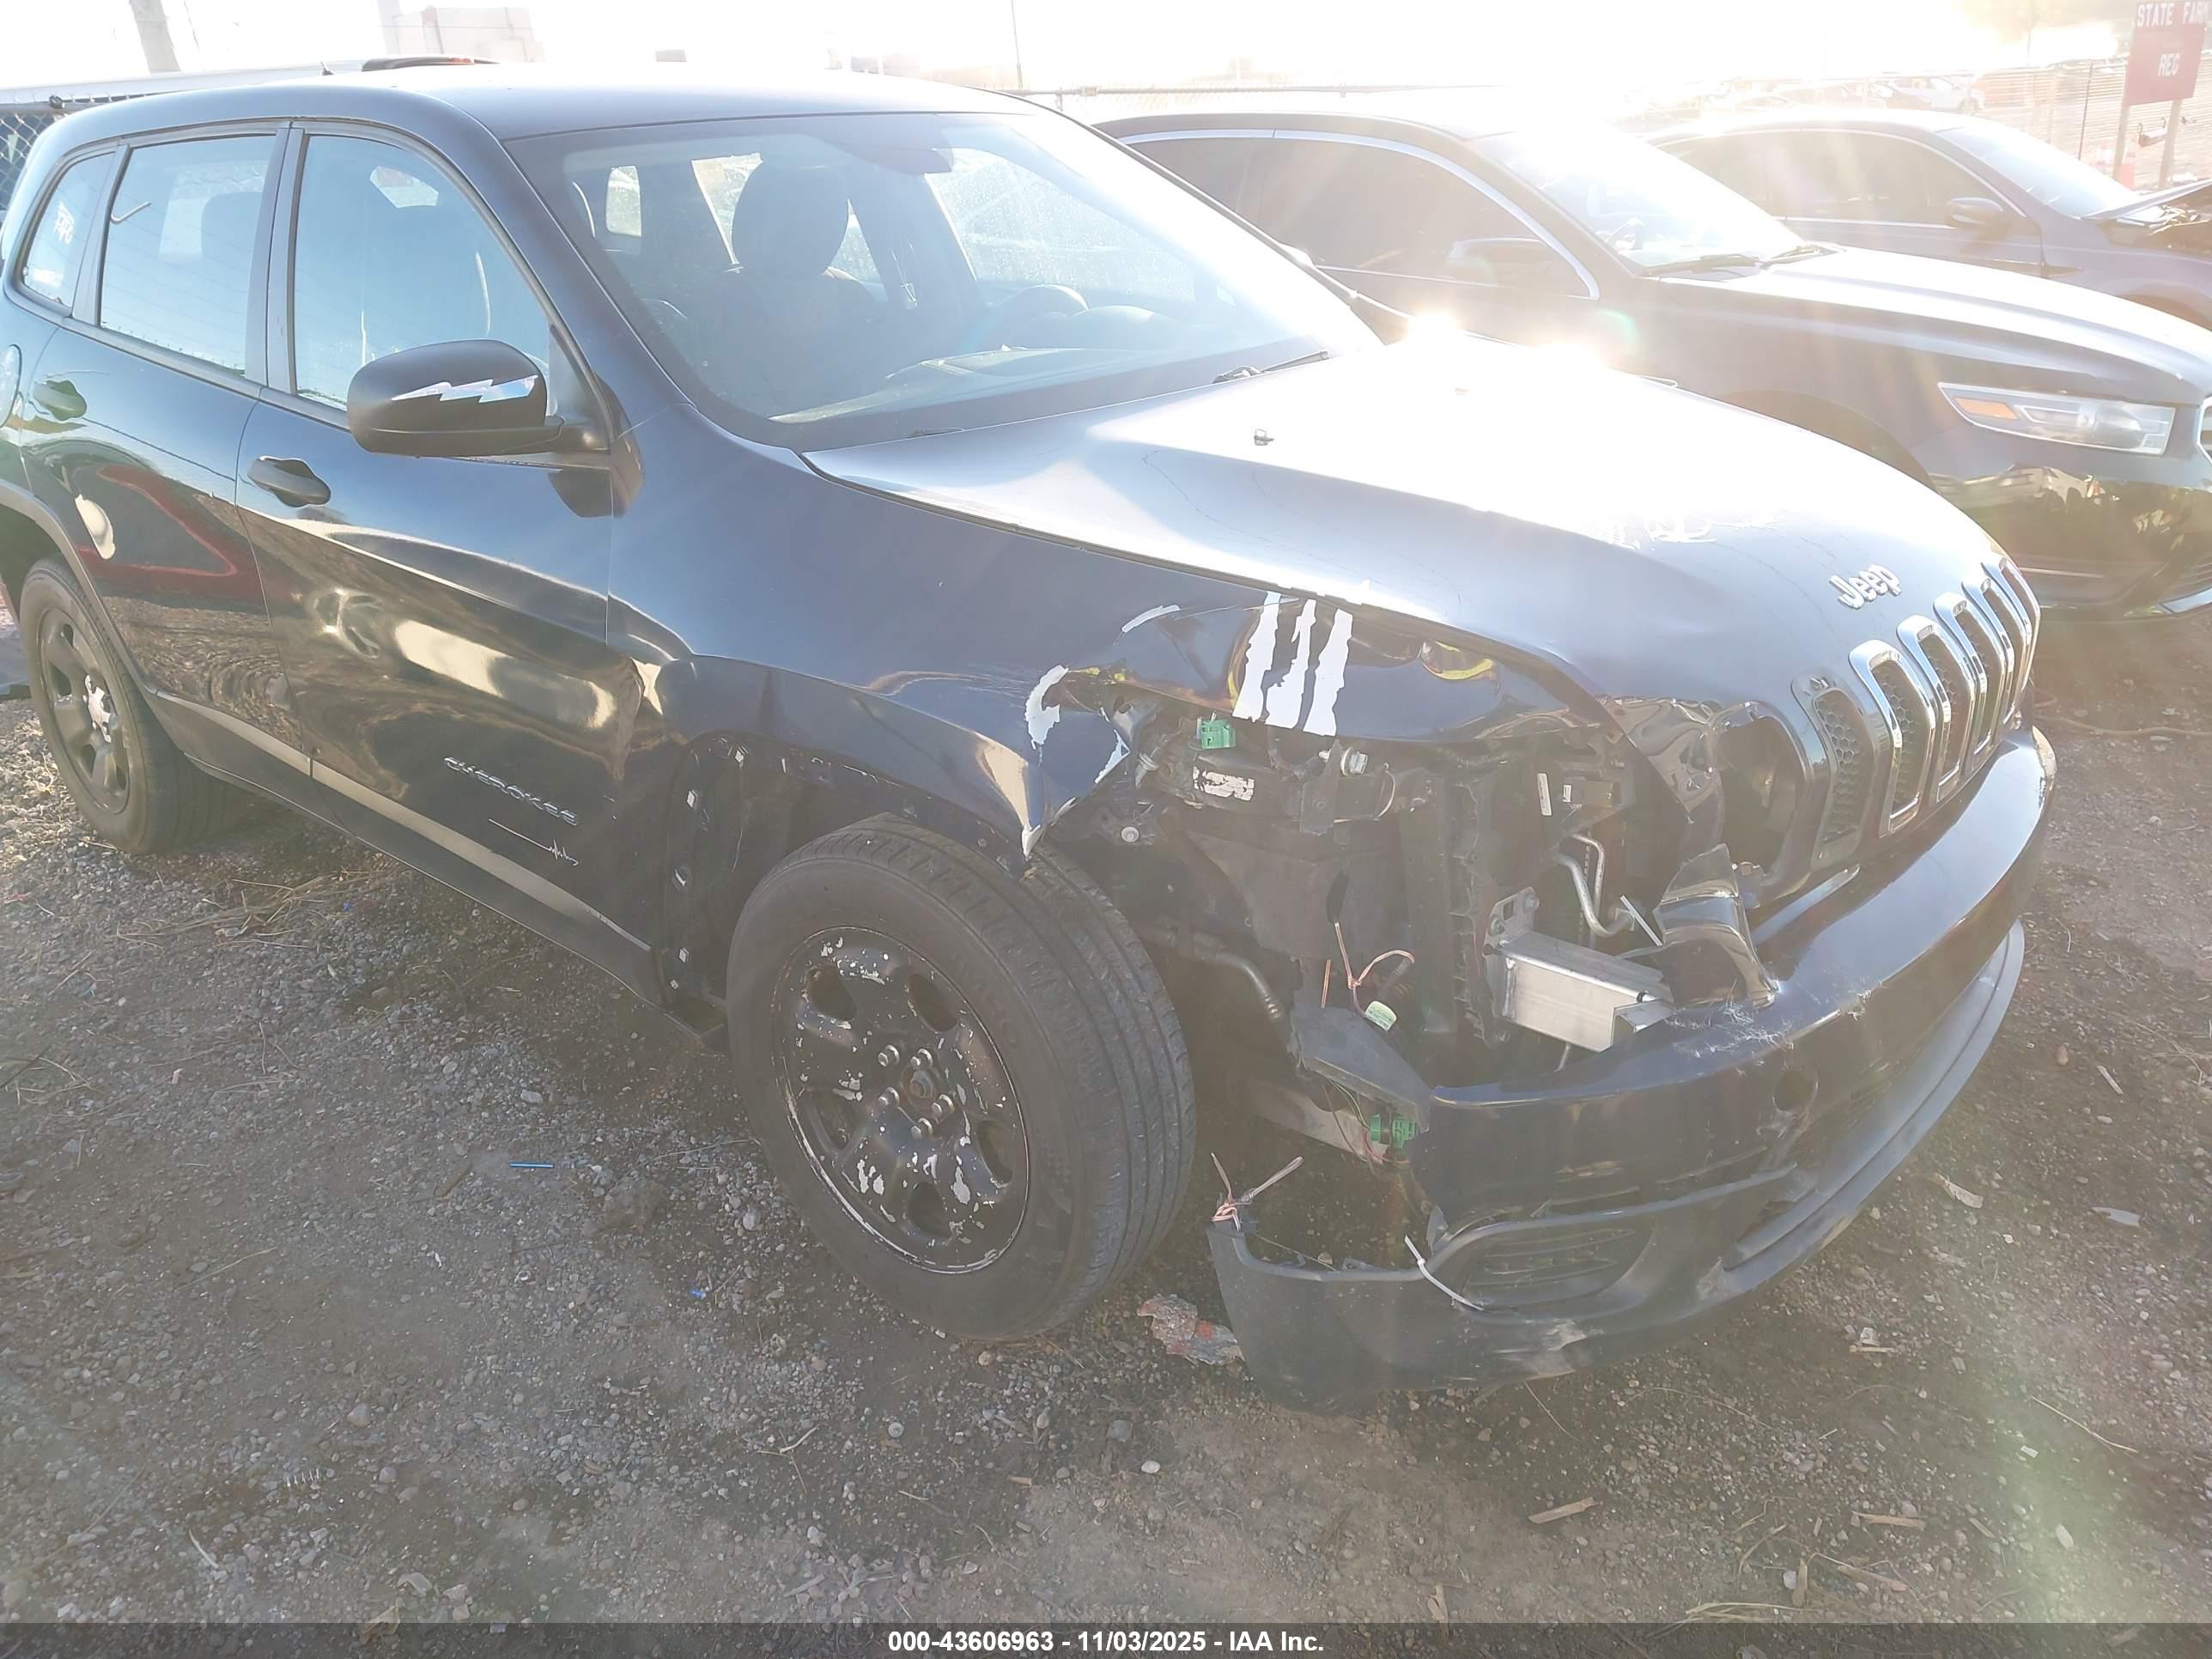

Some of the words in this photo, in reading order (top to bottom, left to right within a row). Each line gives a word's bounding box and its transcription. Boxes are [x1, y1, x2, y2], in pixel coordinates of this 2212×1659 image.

[2136, 3, 2174, 28] STATE
[1828, 563, 1903, 611] Jeep
[442, 756, 578, 826] CHEROKEE
